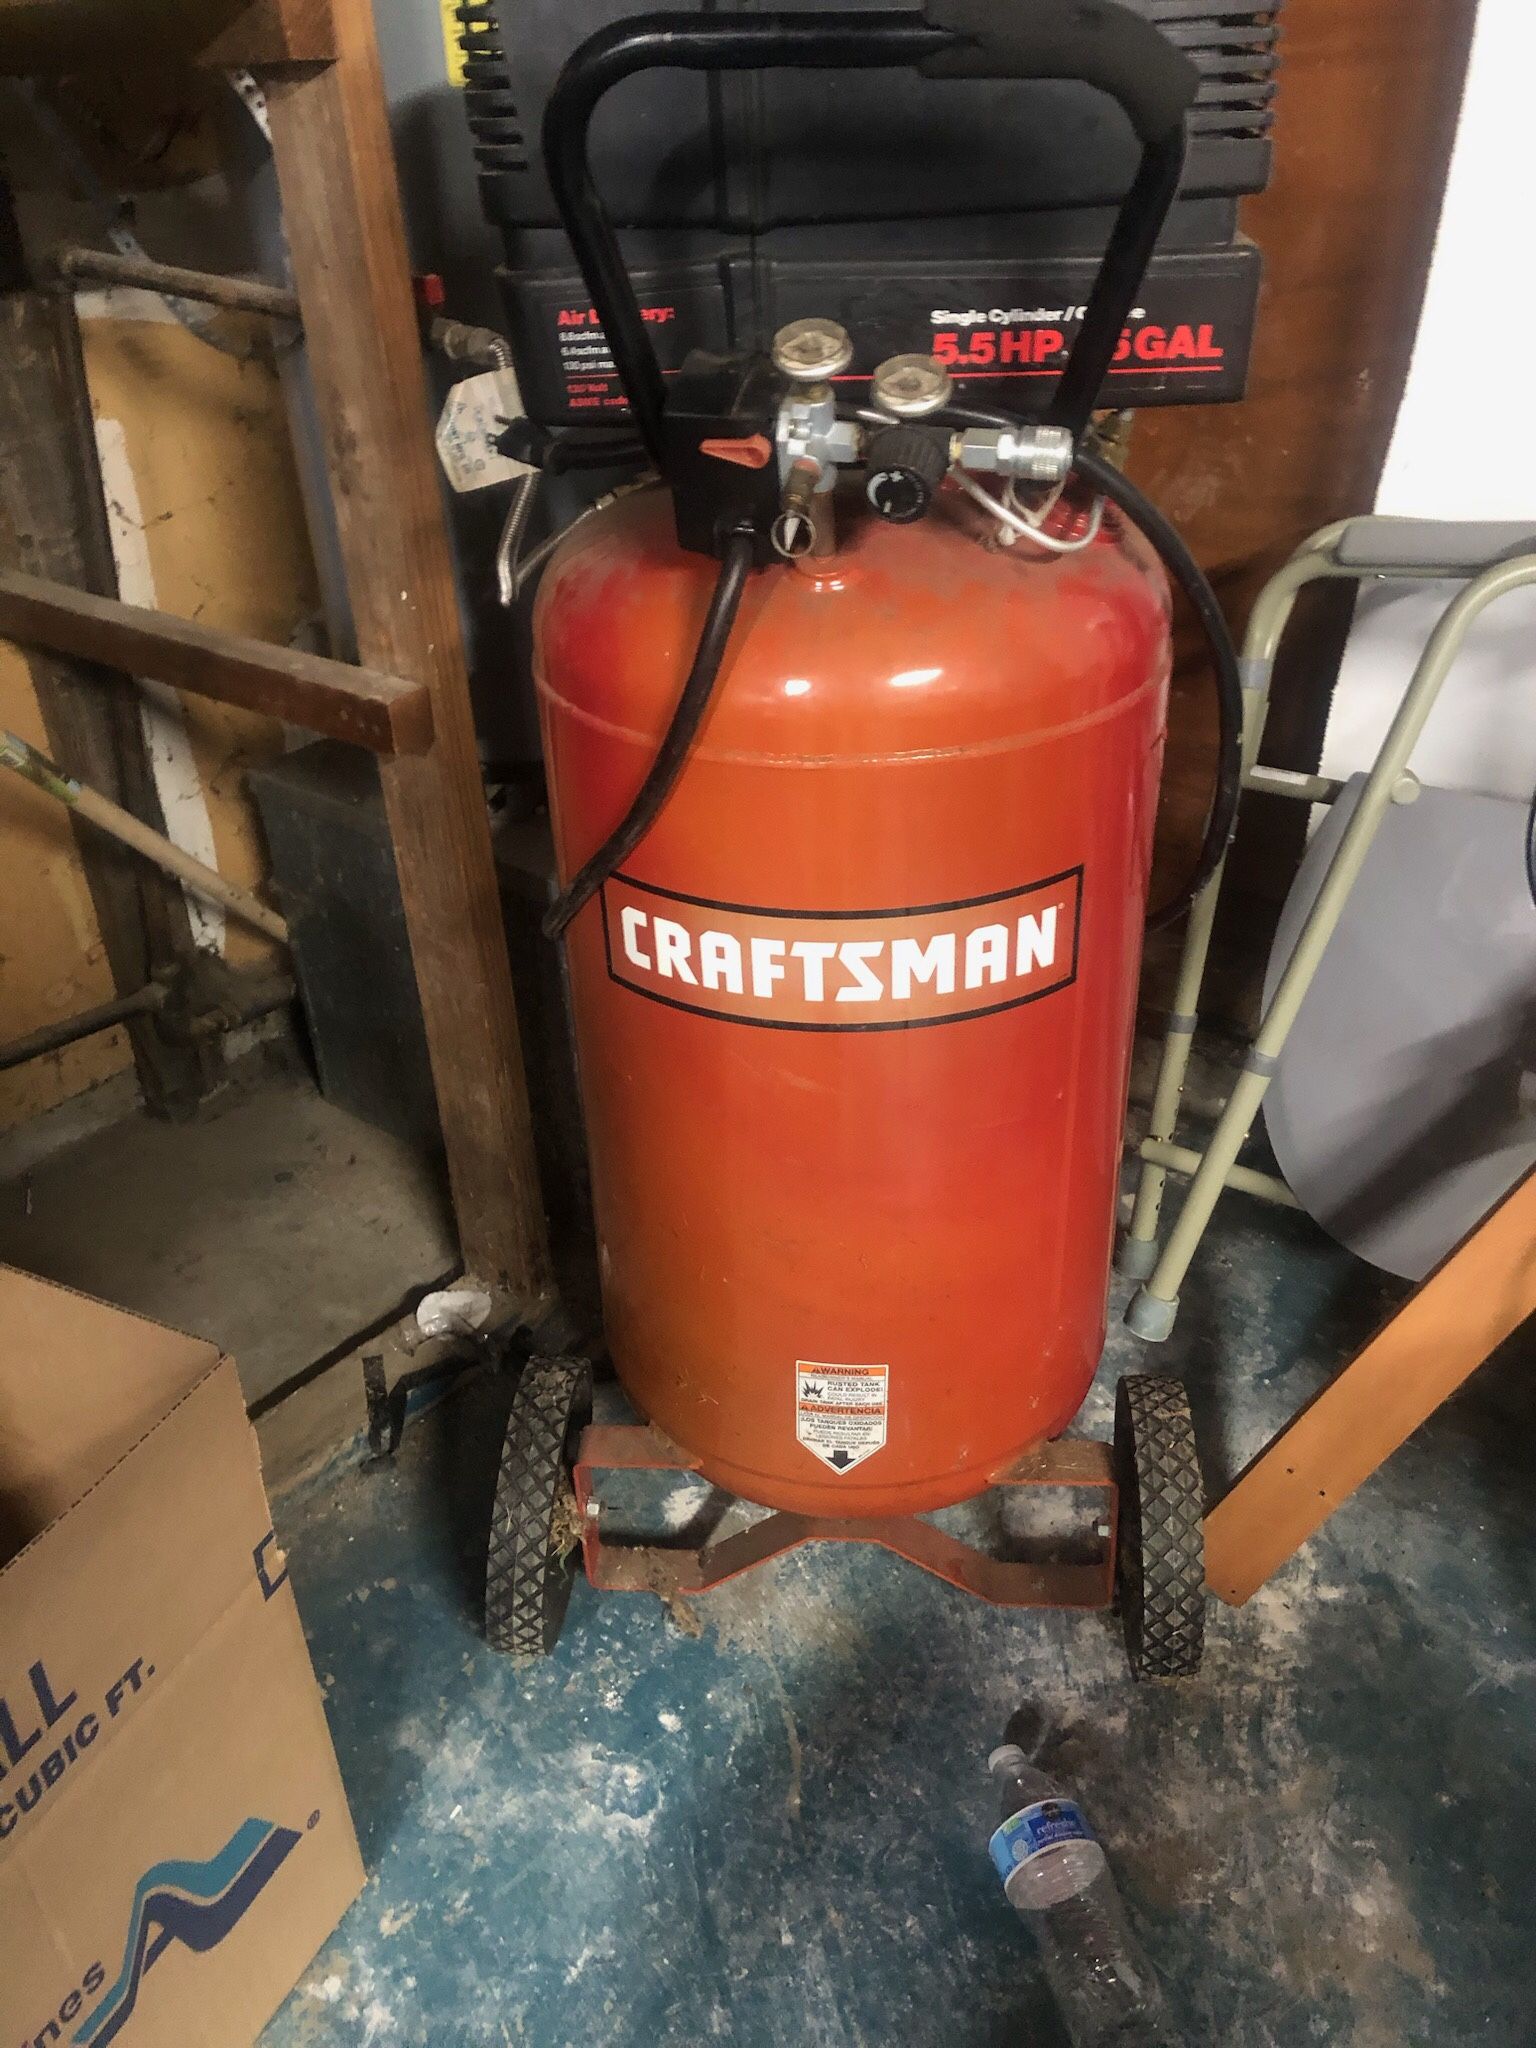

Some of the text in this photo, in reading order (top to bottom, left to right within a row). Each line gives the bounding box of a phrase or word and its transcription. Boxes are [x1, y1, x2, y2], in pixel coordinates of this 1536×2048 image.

[557, 309, 586, 326] Air
[930, 308, 988, 327] Single
[987, 307, 1064, 326] Cylinder
[932, 331, 996, 365] 5.5
[999, 329, 1065, 363] HP
[1133, 323, 1225, 361] GAL
[620, 904, 1058, 1002] CRAFTSMAN
[820, 1367, 869, 1376] WARNING
[810, 1405, 881, 1414] ADVERTENCIA
[809, 1423, 836, 1431] PUEDEN
[816, 1418, 847, 1426] TANQUES
[0, 1656, 156, 1840] CUBIC FT.
